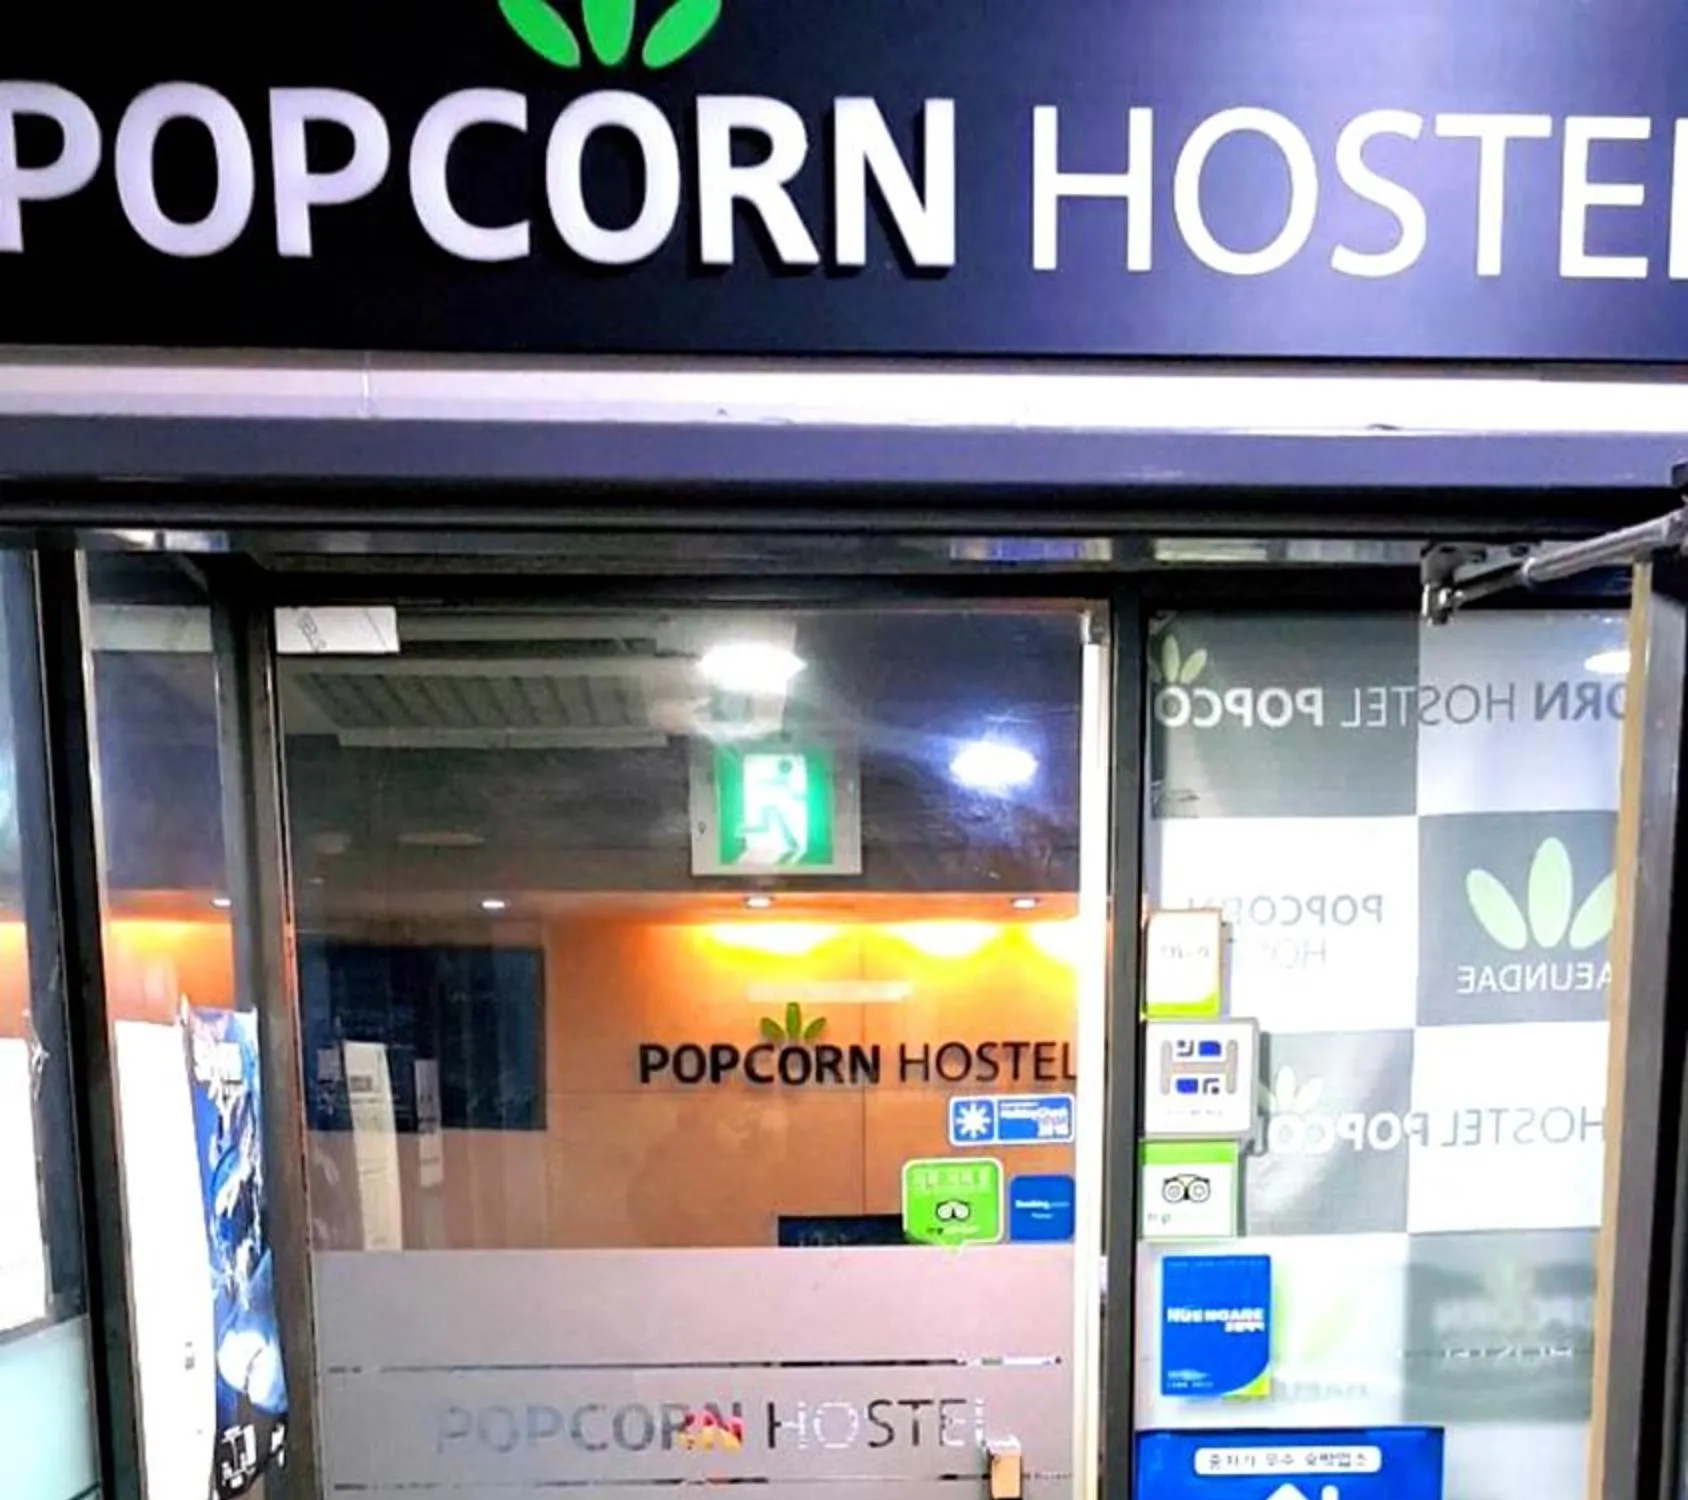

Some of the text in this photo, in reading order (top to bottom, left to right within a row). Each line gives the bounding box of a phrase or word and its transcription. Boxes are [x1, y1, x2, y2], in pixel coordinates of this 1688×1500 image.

[0, 80, 955, 267] POPCORN
[638, 1040, 1077, 1086] POPCORN HOSTEL
[437, 1398, 992, 1455] POPCORN HOSTEL
